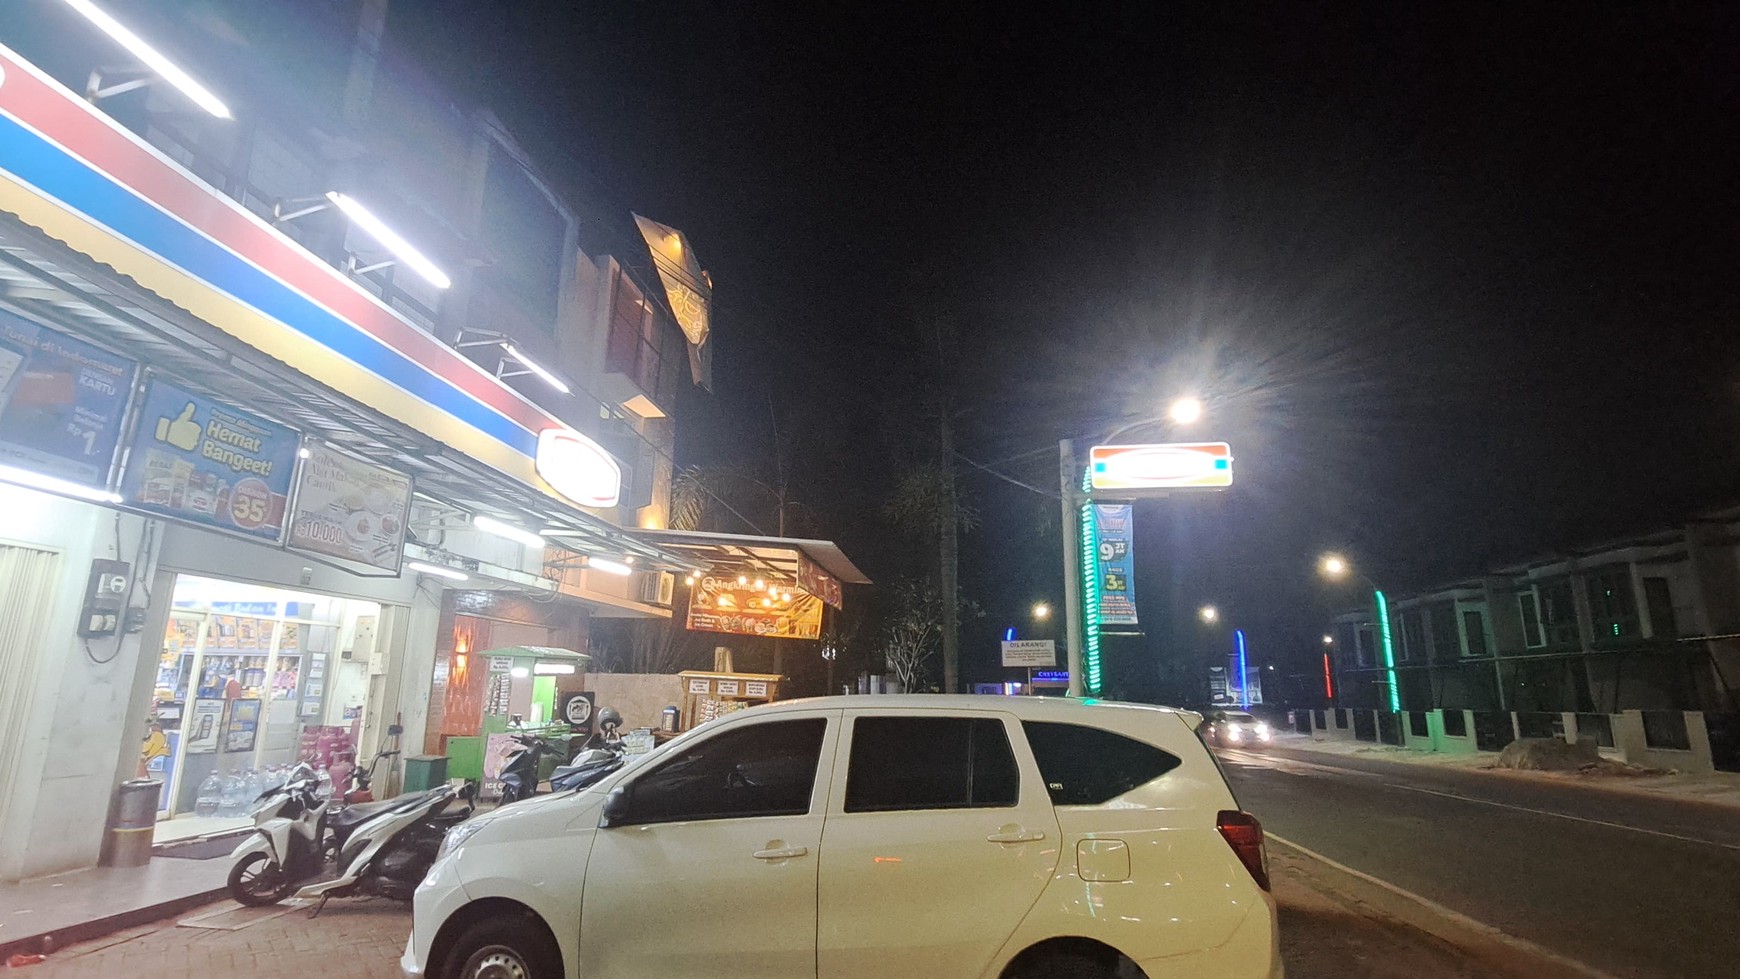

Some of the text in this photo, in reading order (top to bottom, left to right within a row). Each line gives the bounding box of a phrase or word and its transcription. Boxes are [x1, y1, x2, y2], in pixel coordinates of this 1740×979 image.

[41, 339, 54, 353] di
[58, 346, 124, 376] Indomaret
[79, 376, 116, 396] KARTU
[207, 420, 262, 453] Hemat
[202, 440, 273, 477] Bangeet!
[1100, 543, 1114, 561] 9
[1105, 574, 1118, 590] 3
